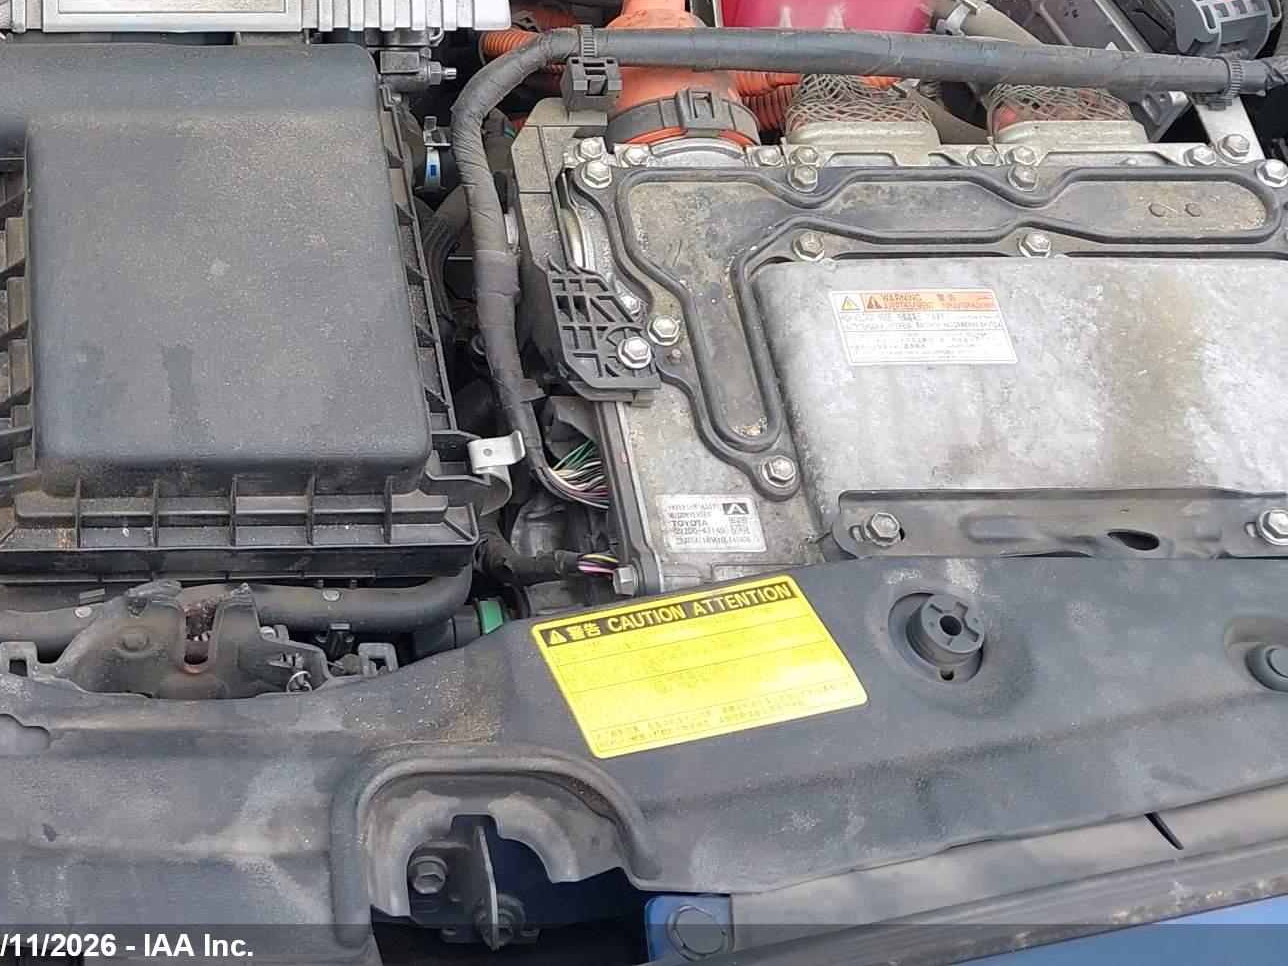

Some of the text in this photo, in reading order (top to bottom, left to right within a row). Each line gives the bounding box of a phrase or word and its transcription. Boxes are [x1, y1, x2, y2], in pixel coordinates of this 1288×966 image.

[881, 293, 922, 302] WARNING
[671, 519, 708, 527] TOYOTA
[567, 583, 793, 641] 警告 CAUTION ATTENTION
